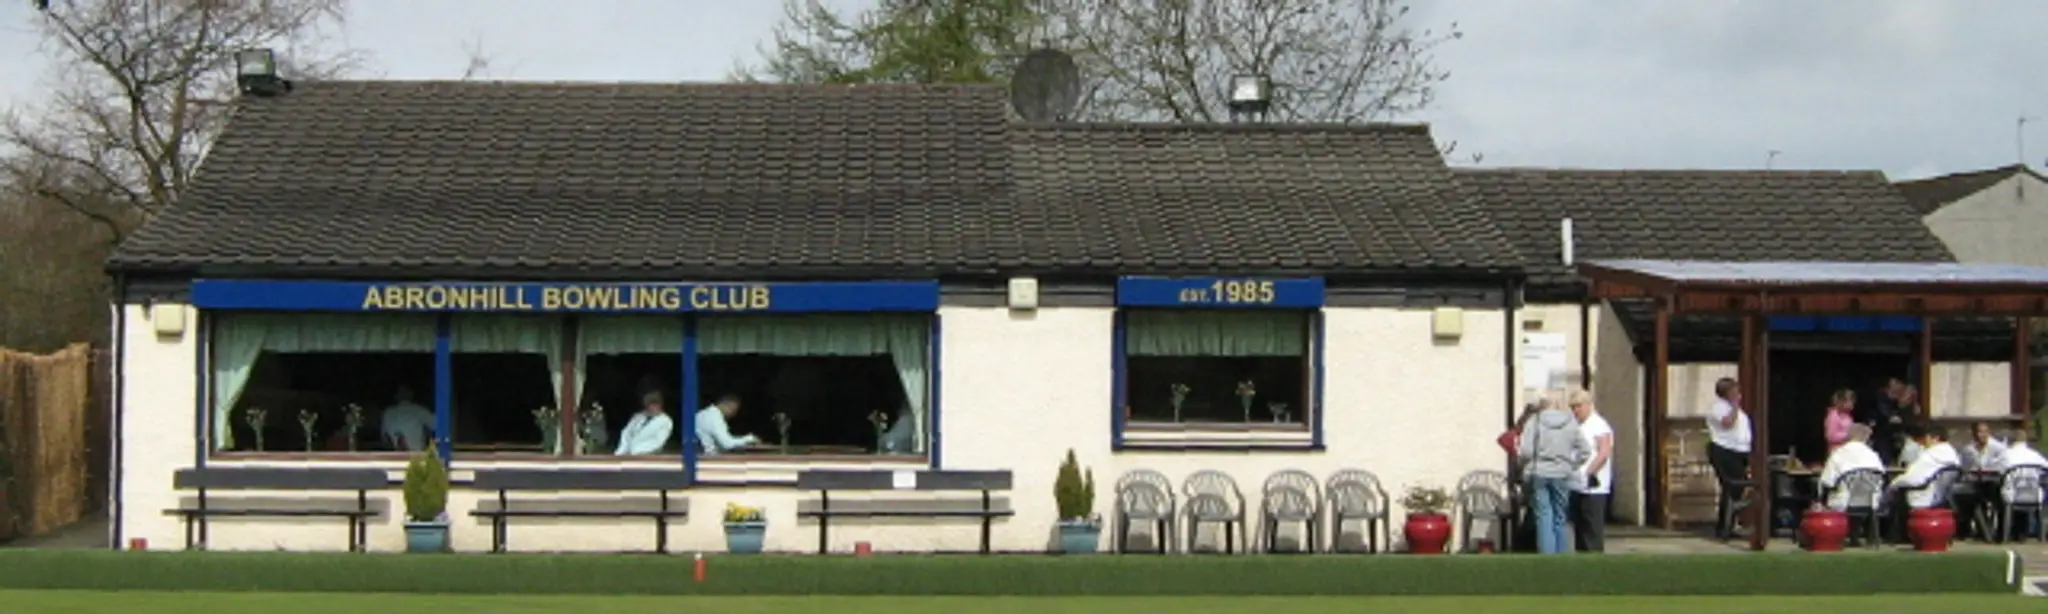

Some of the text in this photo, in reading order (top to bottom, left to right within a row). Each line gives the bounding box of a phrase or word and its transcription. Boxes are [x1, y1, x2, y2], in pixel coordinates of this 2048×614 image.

[362, 285, 770, 309] ABRONHILL BOWLING CLUB
[1212, 280, 1275, 303] 1985
